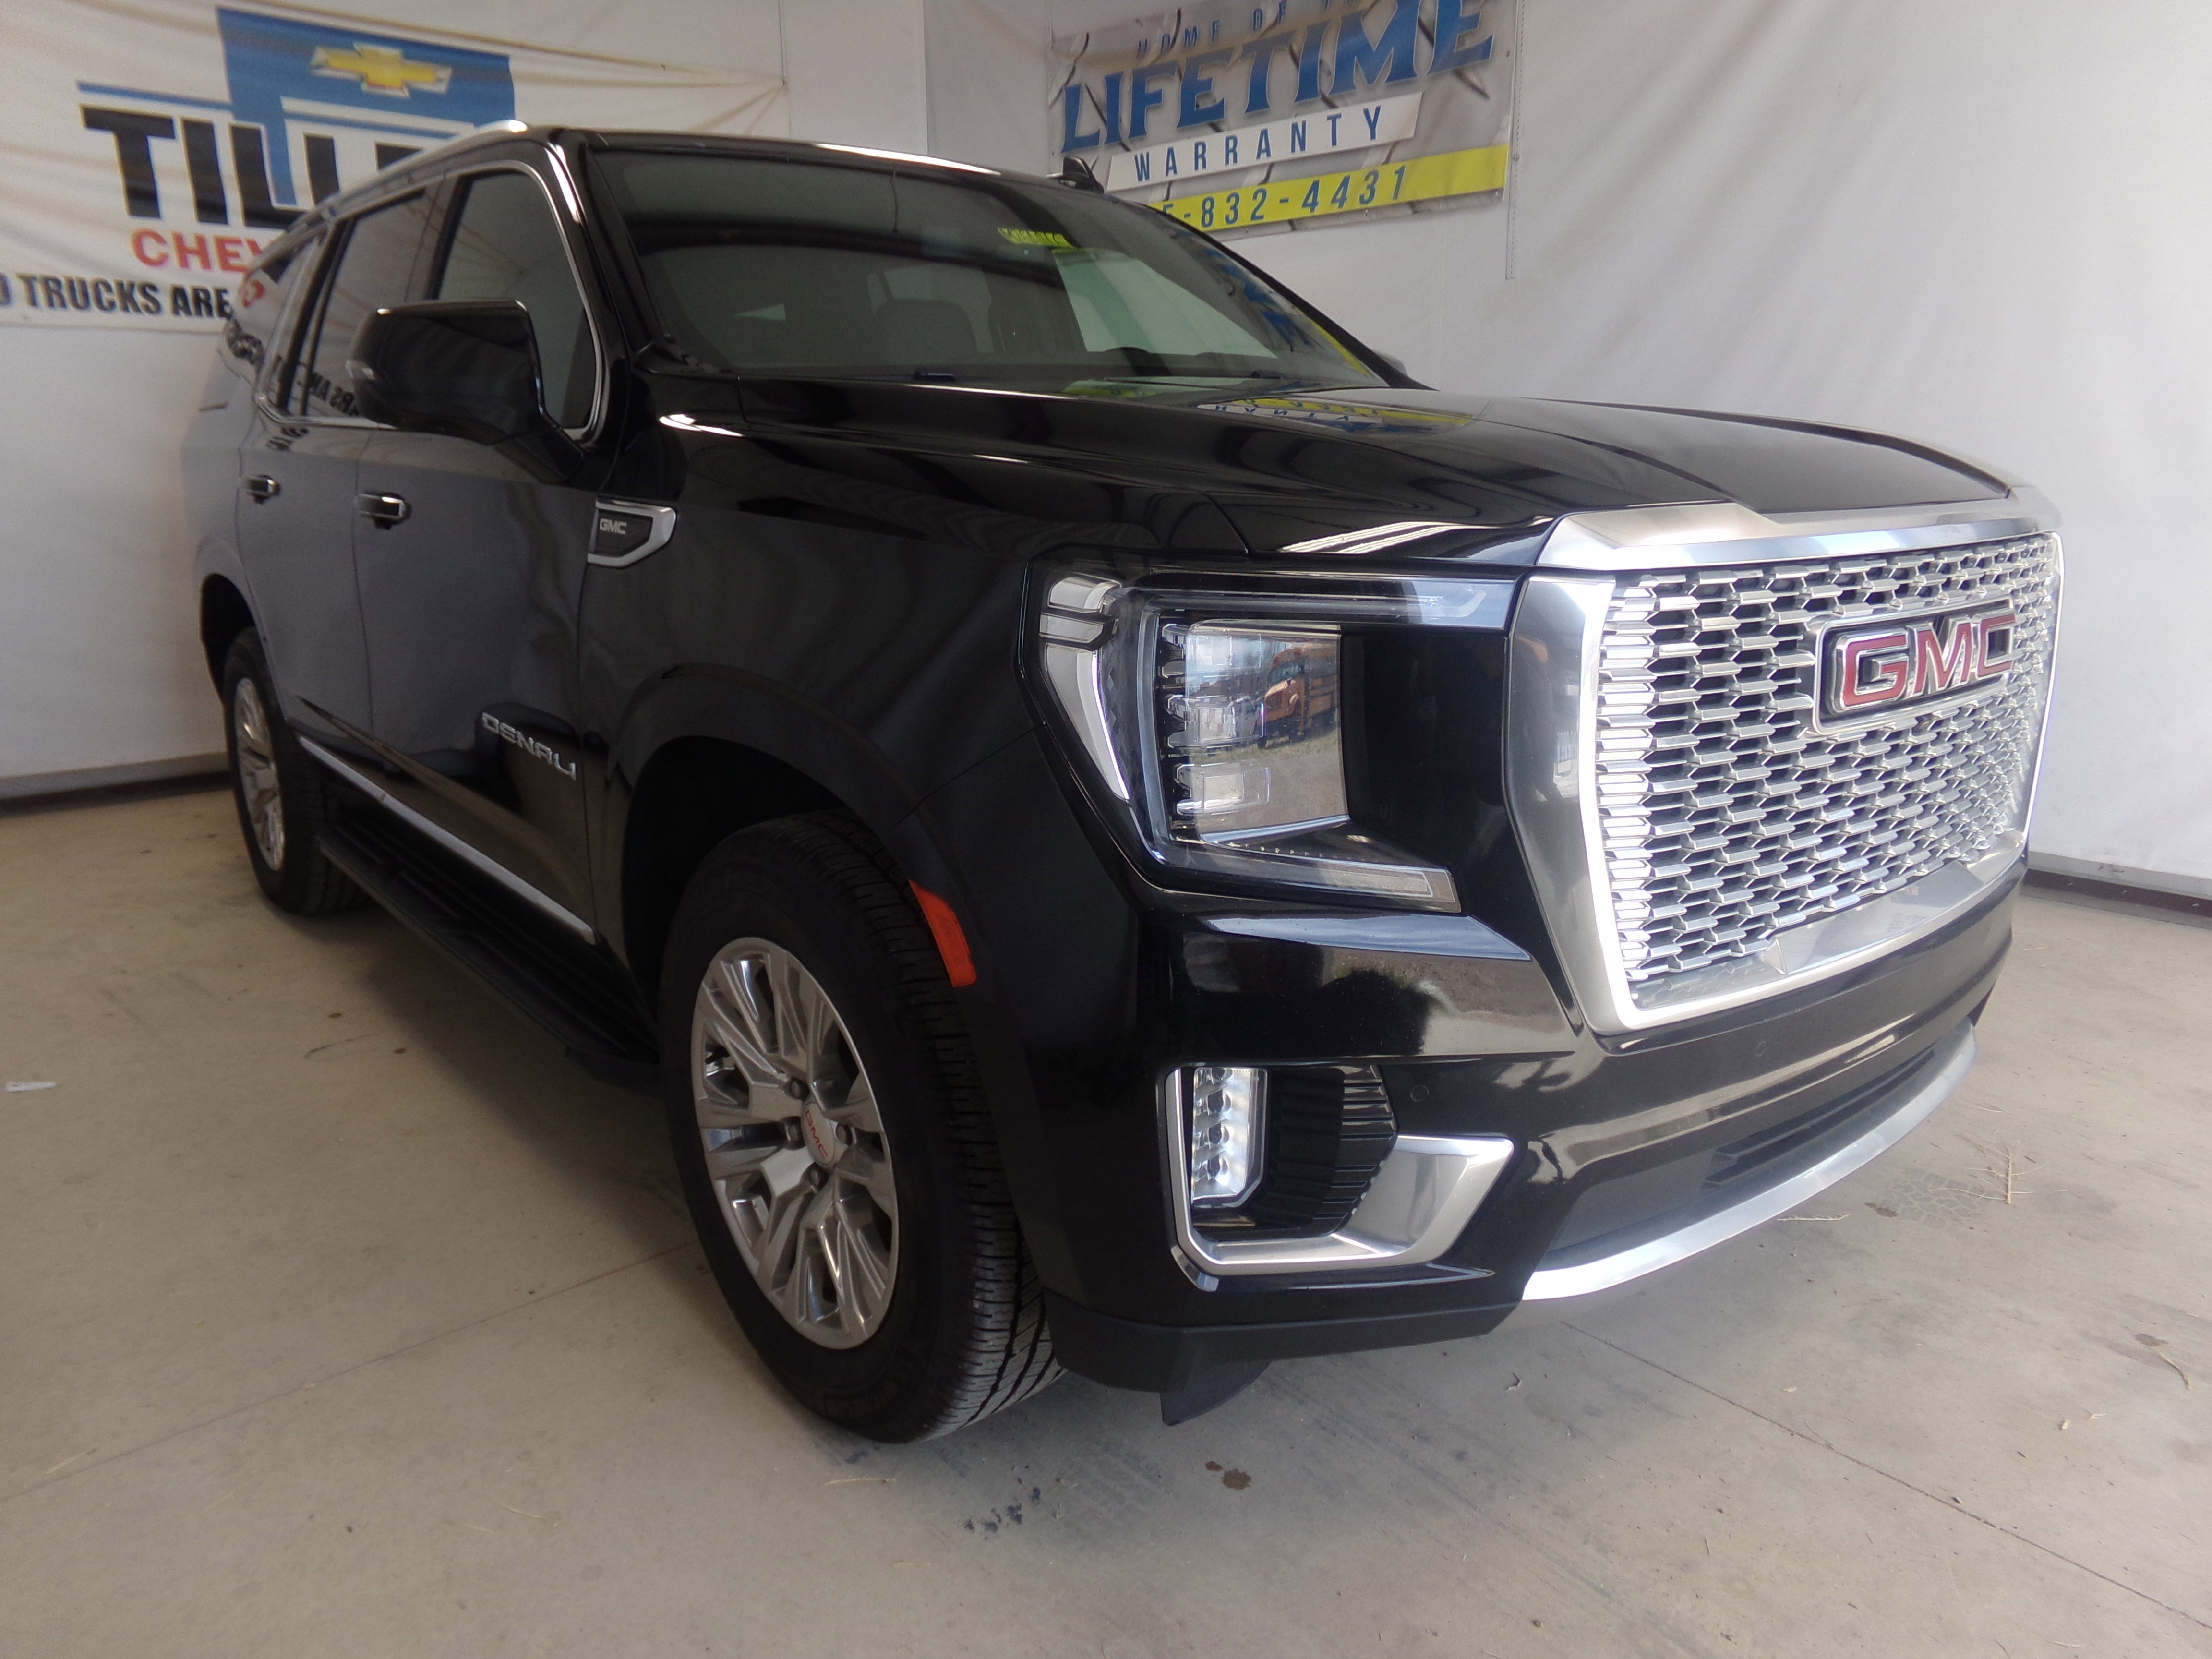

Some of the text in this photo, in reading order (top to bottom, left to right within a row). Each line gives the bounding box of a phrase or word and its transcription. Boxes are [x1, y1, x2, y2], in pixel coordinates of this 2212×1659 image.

[1136, 0, 1288, 60] HOME OF
[1061, 0, 1495, 153] LIFETIME
[1134, 105, 1382, 182] WARRANTY
[15, 273, 161, 314] TRUCKS
[169, 284, 232, 318] ARE
[600, 518, 627, 535] GMC
[1838, 609, 2016, 709] GMC
[482, 712, 576, 780] DENALI
[806, 1110, 828, 1159] GMC
